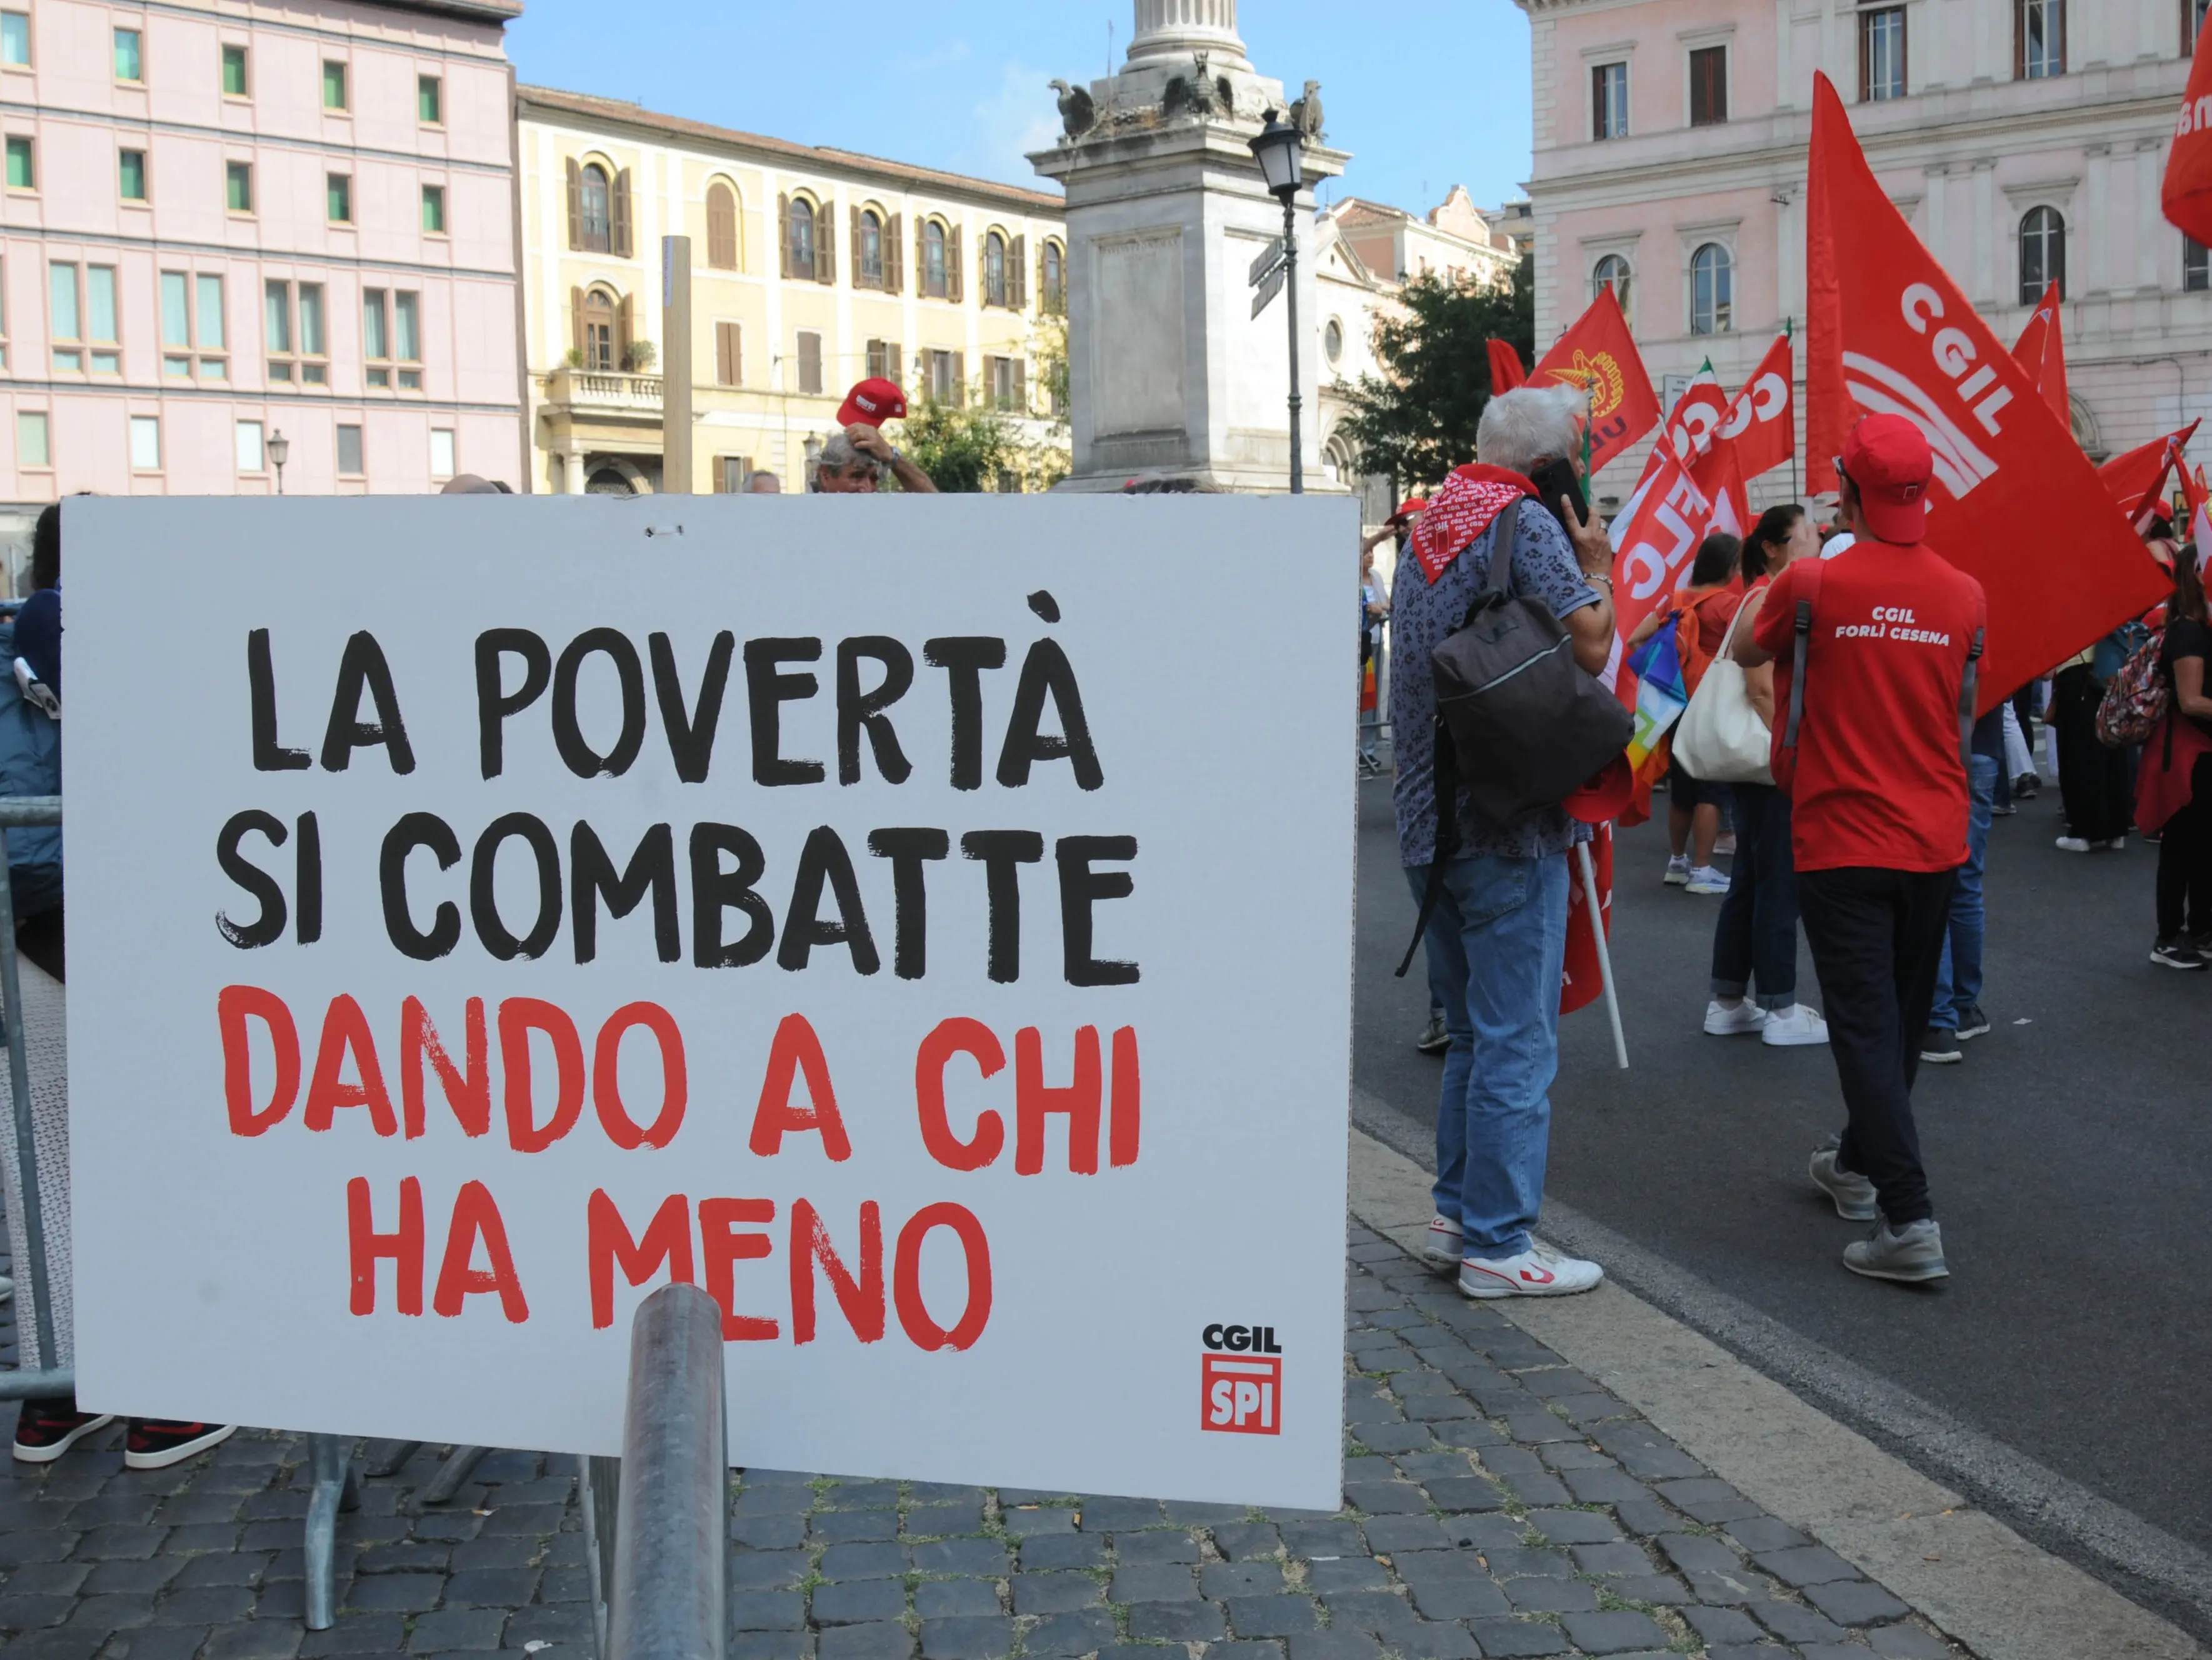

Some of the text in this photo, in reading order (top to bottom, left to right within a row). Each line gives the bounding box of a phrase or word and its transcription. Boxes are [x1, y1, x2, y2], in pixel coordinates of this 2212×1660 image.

[1901, 282, 2014, 438] CGIL
[248, 590, 1104, 791] LA POVERTÀ
[1835, 623, 1949, 646] FORLÌ CESENA
[1872, 606, 1915, 624] CGIL
[216, 810, 1140, 987] SI COMBATTE
[218, 985, 1141, 1176] DANDO A CHI
[347, 1176, 993, 1352] HA MENO
[1202, 1323, 1282, 1354] CGIL
[1210, 1379, 1273, 1428] SPI
